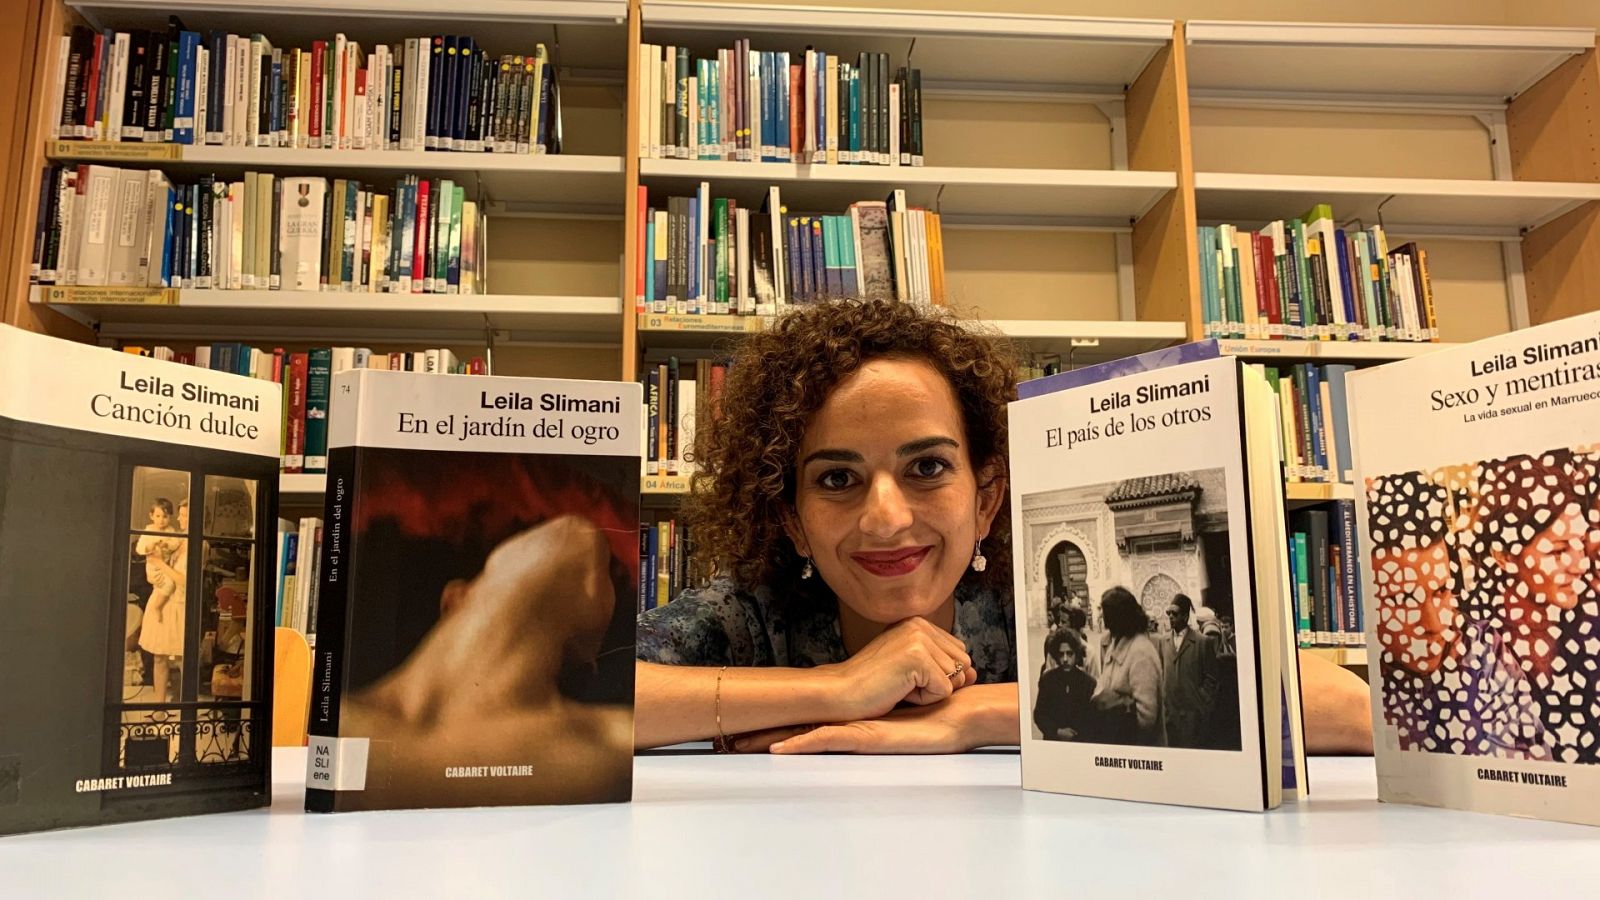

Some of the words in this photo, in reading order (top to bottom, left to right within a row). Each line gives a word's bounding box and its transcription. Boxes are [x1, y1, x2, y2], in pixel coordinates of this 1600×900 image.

[677, 78, 688, 118] AFRICA
[58, 144, 70, 152] 01
[53, 290, 64, 298] 01
[1250, 345, 1280, 353] Europea
[1471, 354, 1518, 377] Leila
[1523, 332, 1600, 365] Sliman
[120, 371, 174, 398] Leila
[181, 382, 259, 412] Slimani
[341, 385, 350, 394] 74
[1090, 392, 1131, 414] Leila
[1136, 374, 1210, 404] Slimani
[1431, 387, 1478, 411] Sexo
[1486, 383, 1499, 406] y
[480, 391, 533, 410] Leila
[540, 393, 620, 414] Slimani
[650, 384, 658, 417] AFRICA
[91, 393, 192, 430] Canción
[200, 412, 258, 440] dulce
[1464, 414, 1476, 423] La
[1478, 409, 1498, 421] vida
[1500, 402, 1532, 416] sexual
[1535, 401, 1548, 410] en
[396, 412, 428, 434] En
[436, 415, 454, 435] el
[458, 415, 526, 441] jardín
[533, 419, 564, 439] del
[571, 424, 619, 445] ogro
[1046, 427, 1062, 448] El
[1067, 421, 1099, 450] país
[1105, 417, 1125, 438] de
[1130, 413, 1156, 432] los
[1162, 406, 1212, 427] otros
[335, 478, 344, 502] ogro
[646, 480, 657, 488] 04
[330, 504, 341, 519] del
[329, 556, 339, 565] el
[328, 568, 338, 582] En
[1347, 575, 1354, 584] EN
[1348, 586, 1354, 594] LA
[1348, 595, 1356, 629] HISTORIA
[321, 651, 333, 692] Slimani
[319, 695, 330, 722] Leila
[316, 746, 329, 756] NA
[315, 758, 329, 768] SLI
[445, 766, 488, 778] CABARET
[490, 765, 533, 777] VOLTAIRE
[1095, 756, 1127, 768] CABARET
[1128, 759, 1163, 771] VOLTAIRE
[76, 777, 124, 792] CABARET
[126, 773, 172, 788] VOLTAIRE
[314, 772, 330, 780] ene
[1477, 768, 1519, 783] CABARET
[1521, 772, 1567, 787] VOLTAIRE
